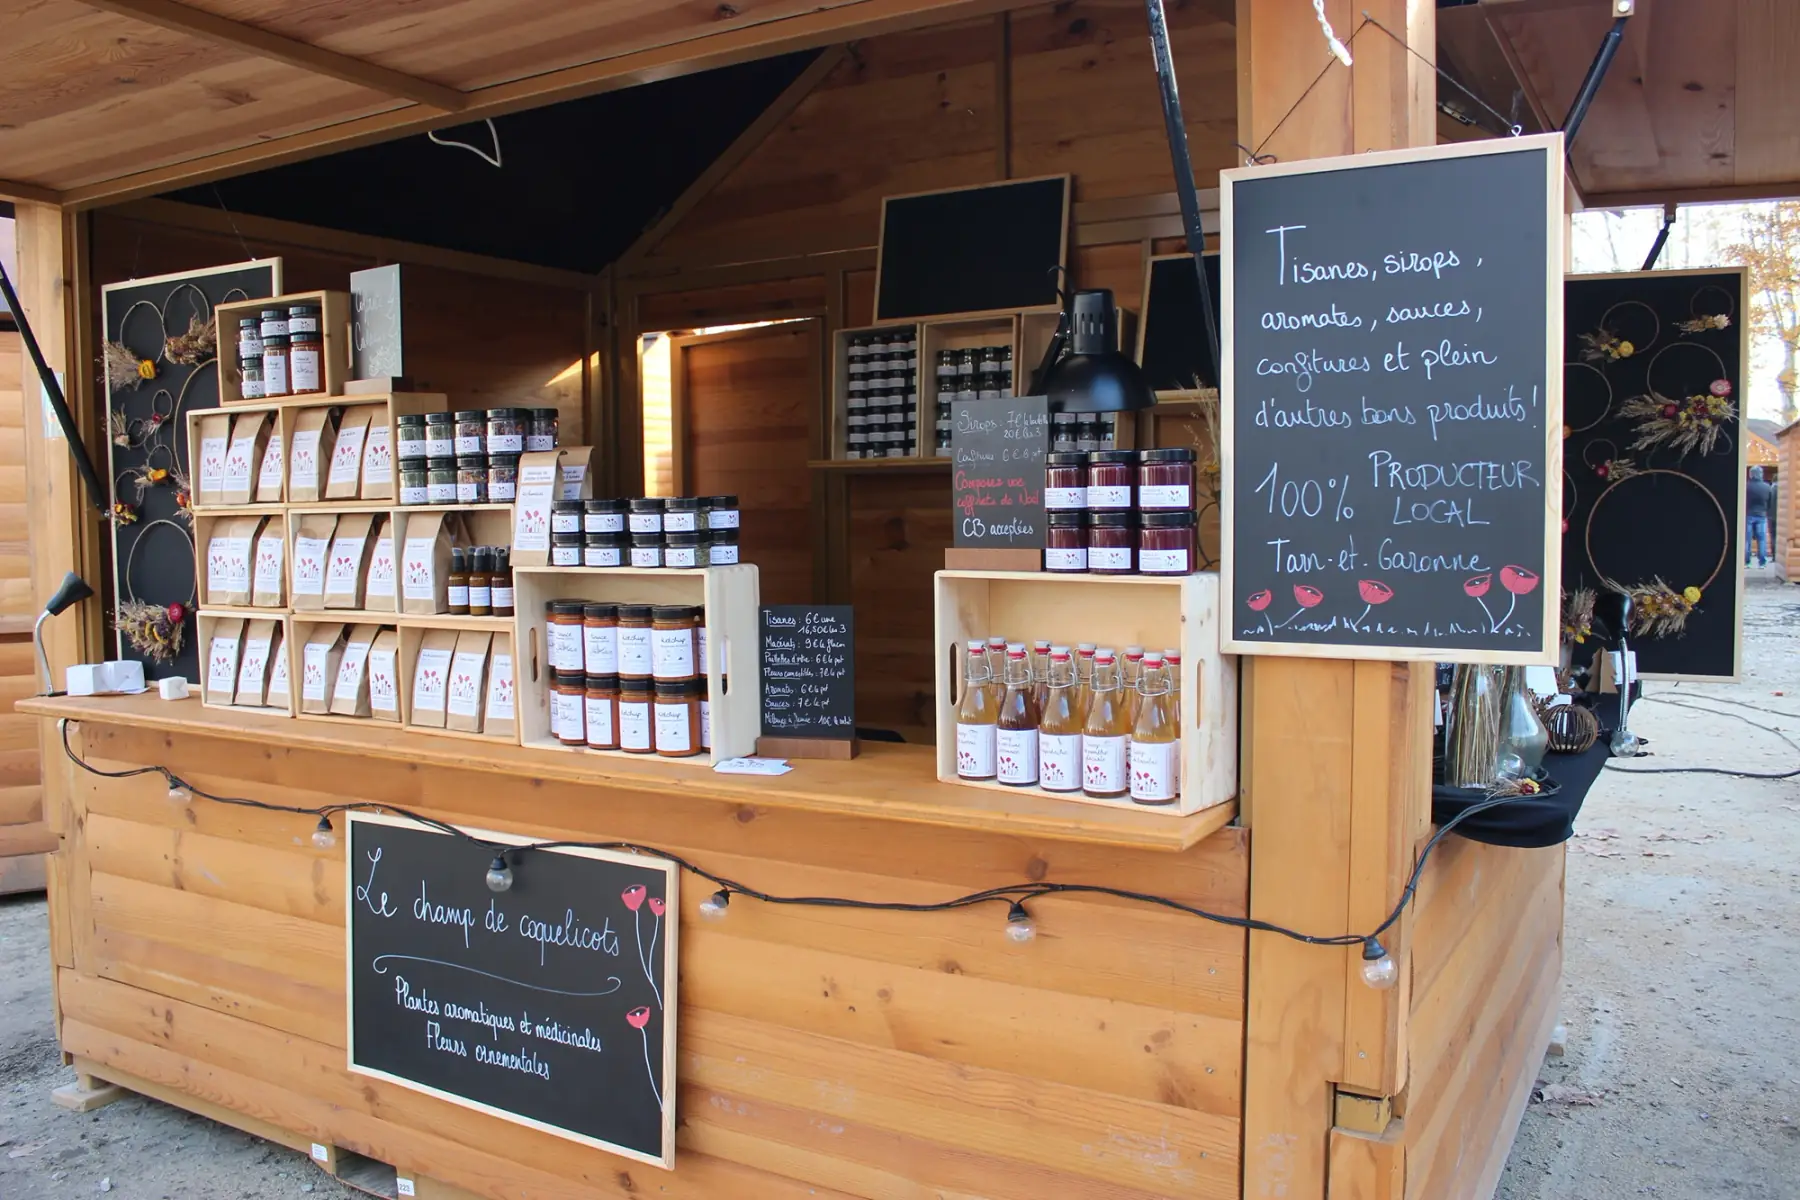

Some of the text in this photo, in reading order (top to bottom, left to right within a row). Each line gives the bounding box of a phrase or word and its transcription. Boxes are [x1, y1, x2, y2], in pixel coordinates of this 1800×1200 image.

[1266, 225, 1377, 284] Tisanes,
[1261, 300, 1482, 332] aromates, sauces,
[1256, 339, 1498, 392] confitures et plein
[1035, 427, 1042, 438] 3
[1256, 398, 1352, 428] d'autres
[1362, 396, 1416, 425] bons
[1255, 450, 1540, 521] 100% PRODUCTEUR
[962, 517, 1034, 543] CB acceptées
[1393, 496, 1490, 528] LOCAL
[839, 624, 847, 634] 3
[356, 847, 620, 966] Le champ de coquelicots
[395, 974, 602, 1053] Plantes aromatiques et médicinales
[426, 1020, 550, 1081] Fleurs ornementales
